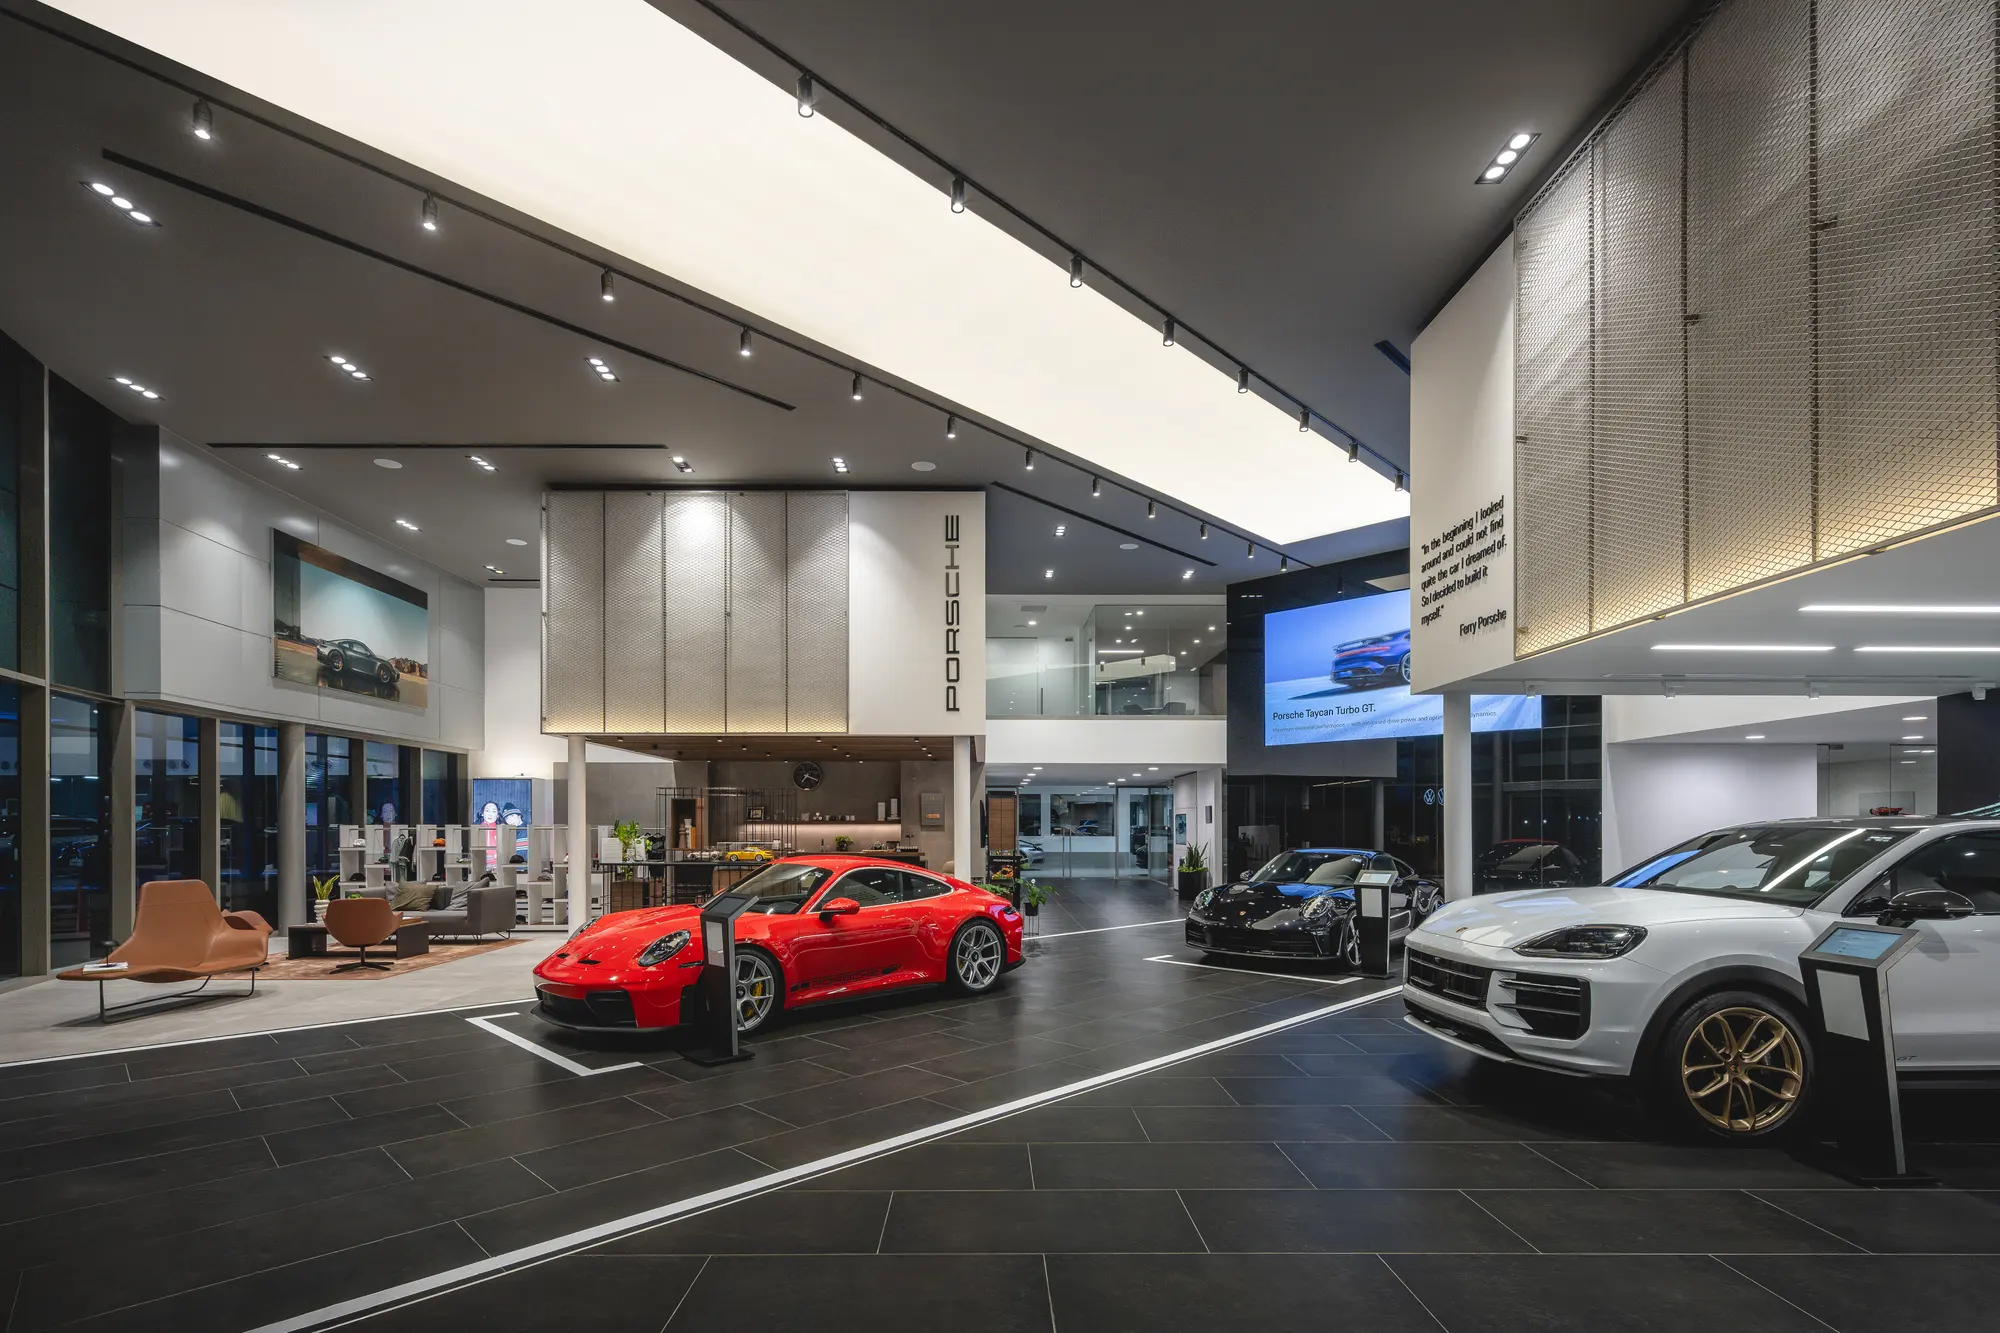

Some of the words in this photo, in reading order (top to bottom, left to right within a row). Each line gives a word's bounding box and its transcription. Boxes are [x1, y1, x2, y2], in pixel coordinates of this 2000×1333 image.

[1421, 556, 1441, 573] around
[1442, 546, 1454, 561] and
[1455, 534, 1474, 553] could
[1476, 526, 1488, 542] not
[1490, 514, 1504, 534] find
[1430, 535, 1441, 550] the
[1442, 519, 1474, 542] beginning
[1480, 495, 1504, 521] looked
[1421, 575, 1436, 592] quite
[1437, 568, 1448, 581] the
[1449, 562, 1459, 575] car
[1466, 540, 1496, 567] dreamed
[1497, 534, 1507, 549] of.
[1421, 595, 1429, 608] So
[1432, 582, 1457, 602] decided
[1457, 578, 1464, 590] to
[1465, 566, 1482, 586] build
[1482, 565, 1489, 577] it
[945, 515, 960, 712] PORSCHE
[1459, 621, 1477, 637] Ferry
[1478, 609, 1507, 629] Porsche
[1273, 711, 1304, 720] Porsche
[1306, 708, 1334, 719] Taycan
[1336, 705, 1360, 715] Turbo
[1362, 703, 1376, 712] GT.
